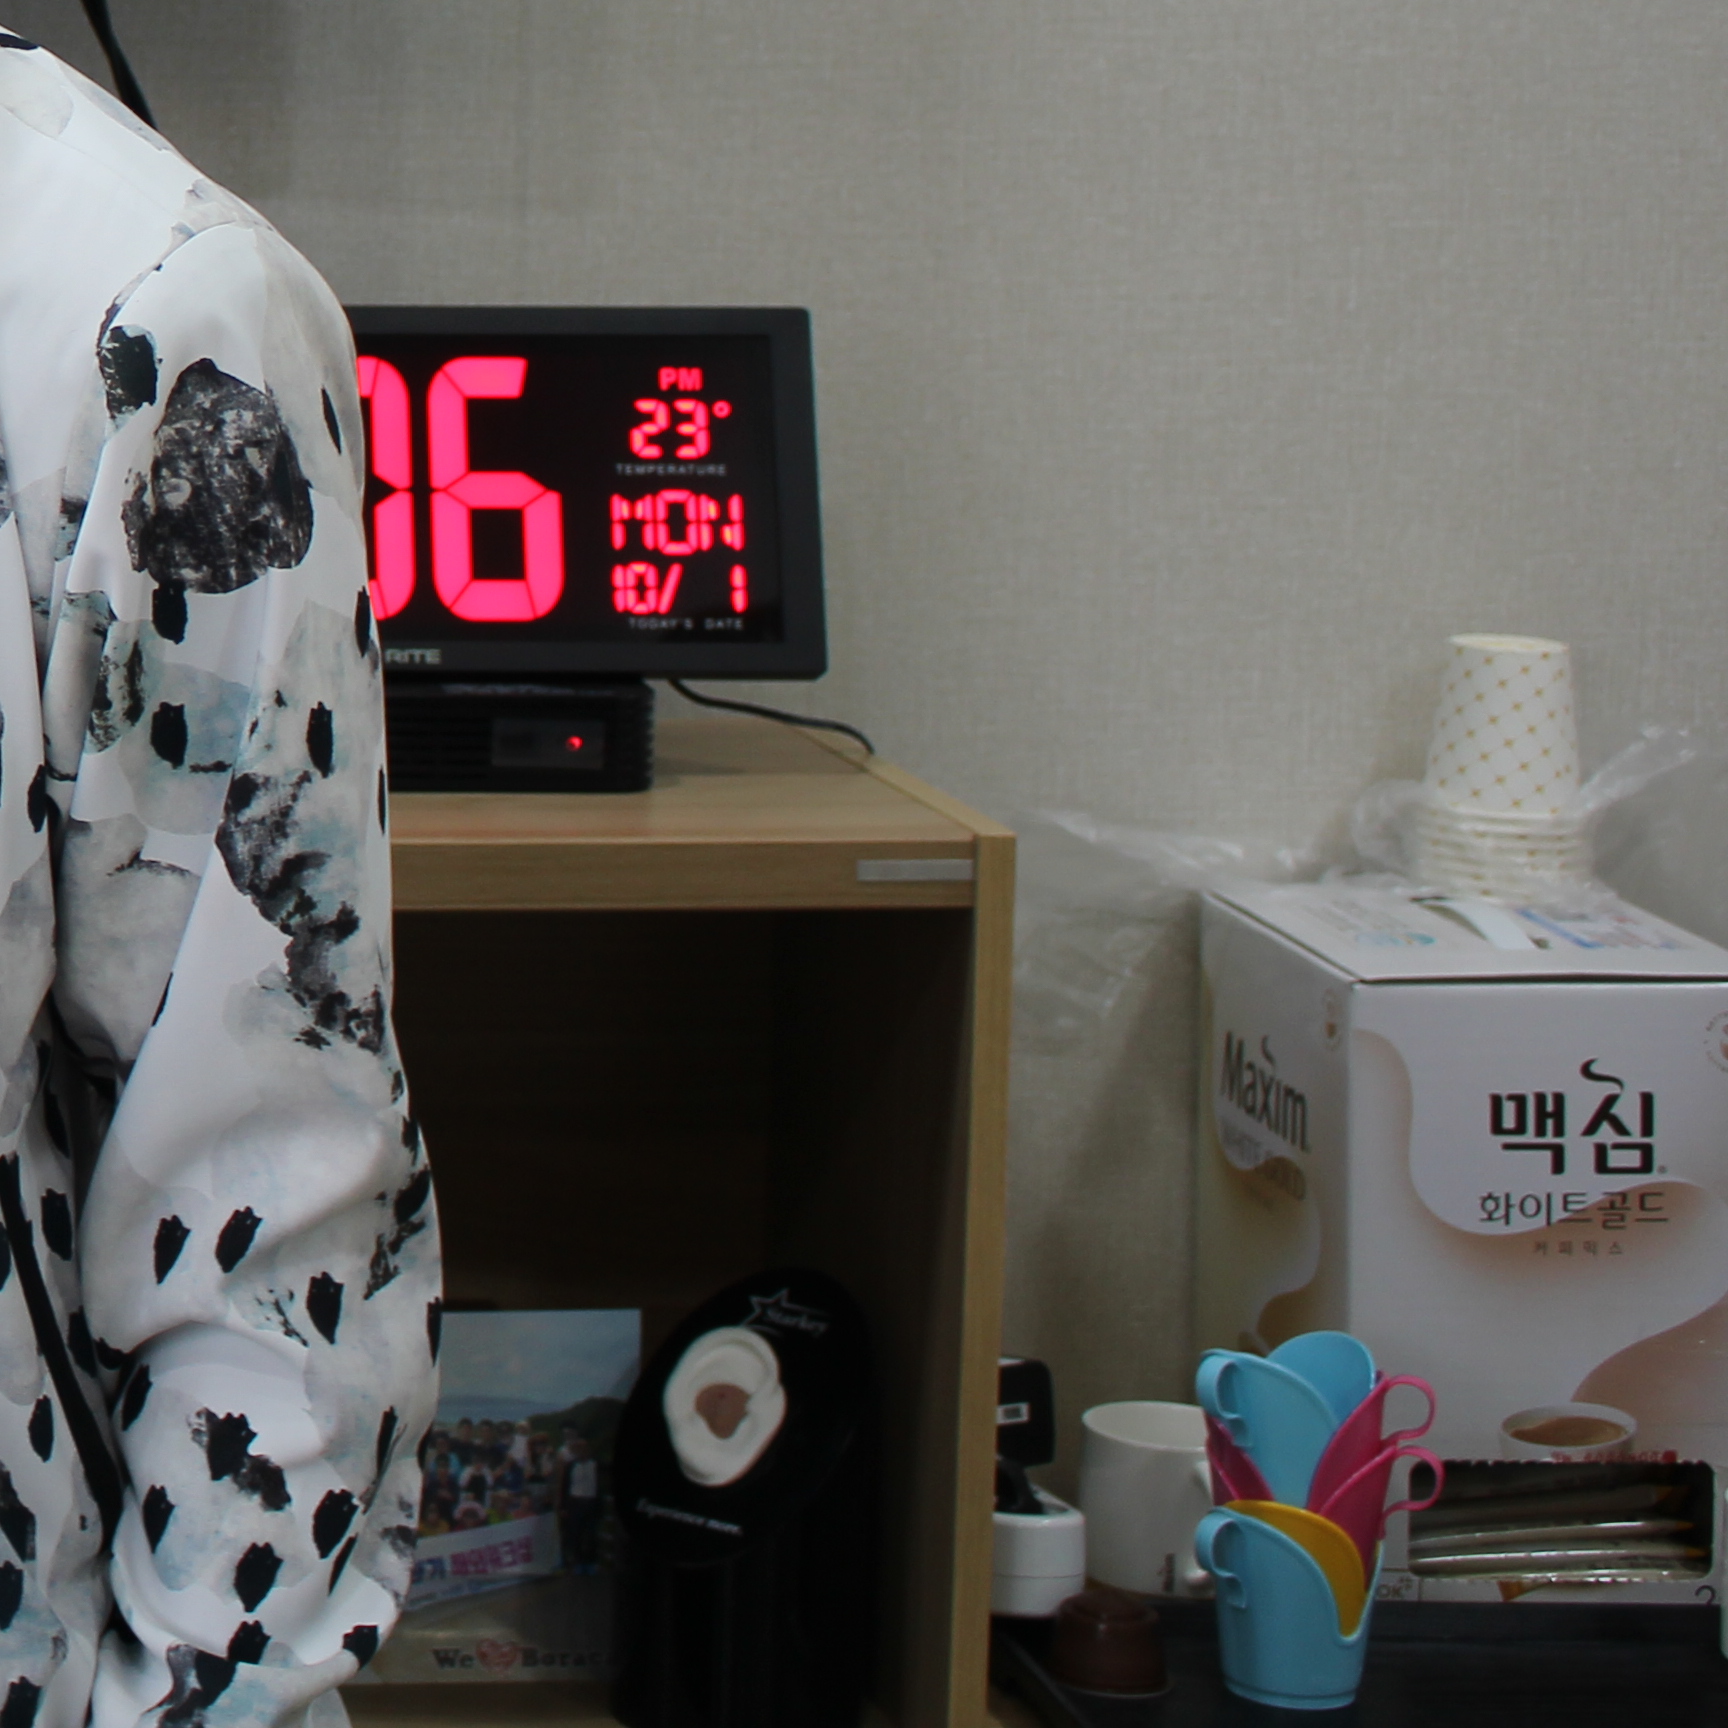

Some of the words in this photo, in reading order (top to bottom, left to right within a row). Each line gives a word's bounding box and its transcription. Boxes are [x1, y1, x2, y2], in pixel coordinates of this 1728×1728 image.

[658, 367, 703, 391] PM
[616, 463, 726, 476] TEMPERATURE
[610, 489, 743, 556] MON
[629, 618, 693, 630] TODAY'S
[705, 618, 743, 630] DATE
[1220, 1028, 1311, 1153] Maxim
[1488, 1058, 1656, 1176] 맥심
[1479, 1190, 1670, 1230] 화이트골드
[432, 1647, 475, 1670] We
